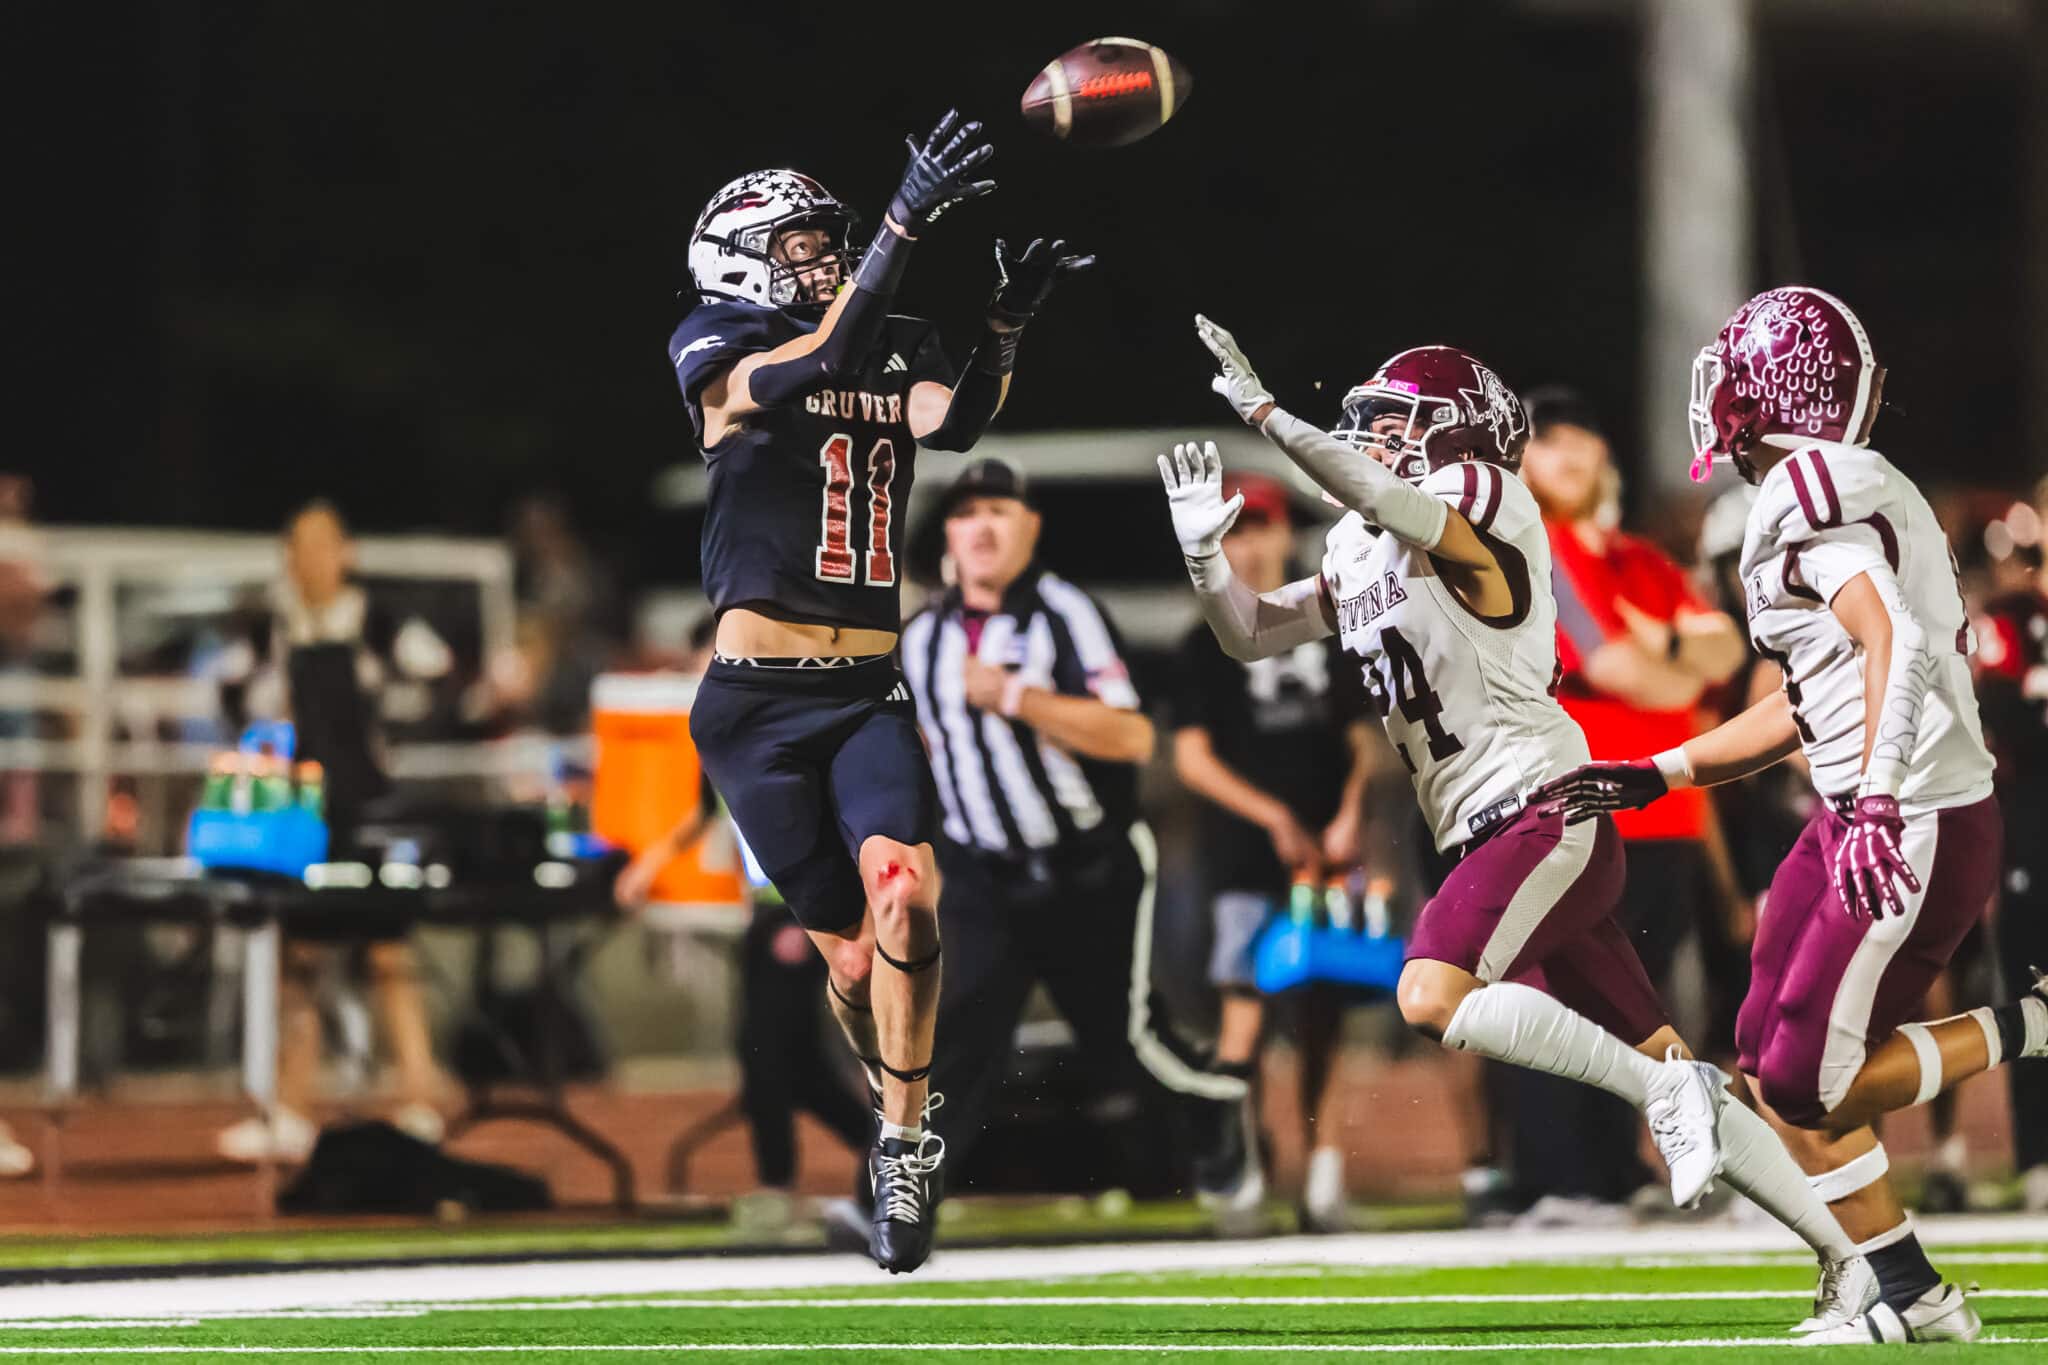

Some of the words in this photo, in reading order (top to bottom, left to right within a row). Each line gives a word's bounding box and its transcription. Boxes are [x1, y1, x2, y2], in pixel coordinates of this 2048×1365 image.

[805, 389, 901, 424] GRUVER
[815, 433, 895, 587] 11
[1343, 627, 1464, 773] 24
